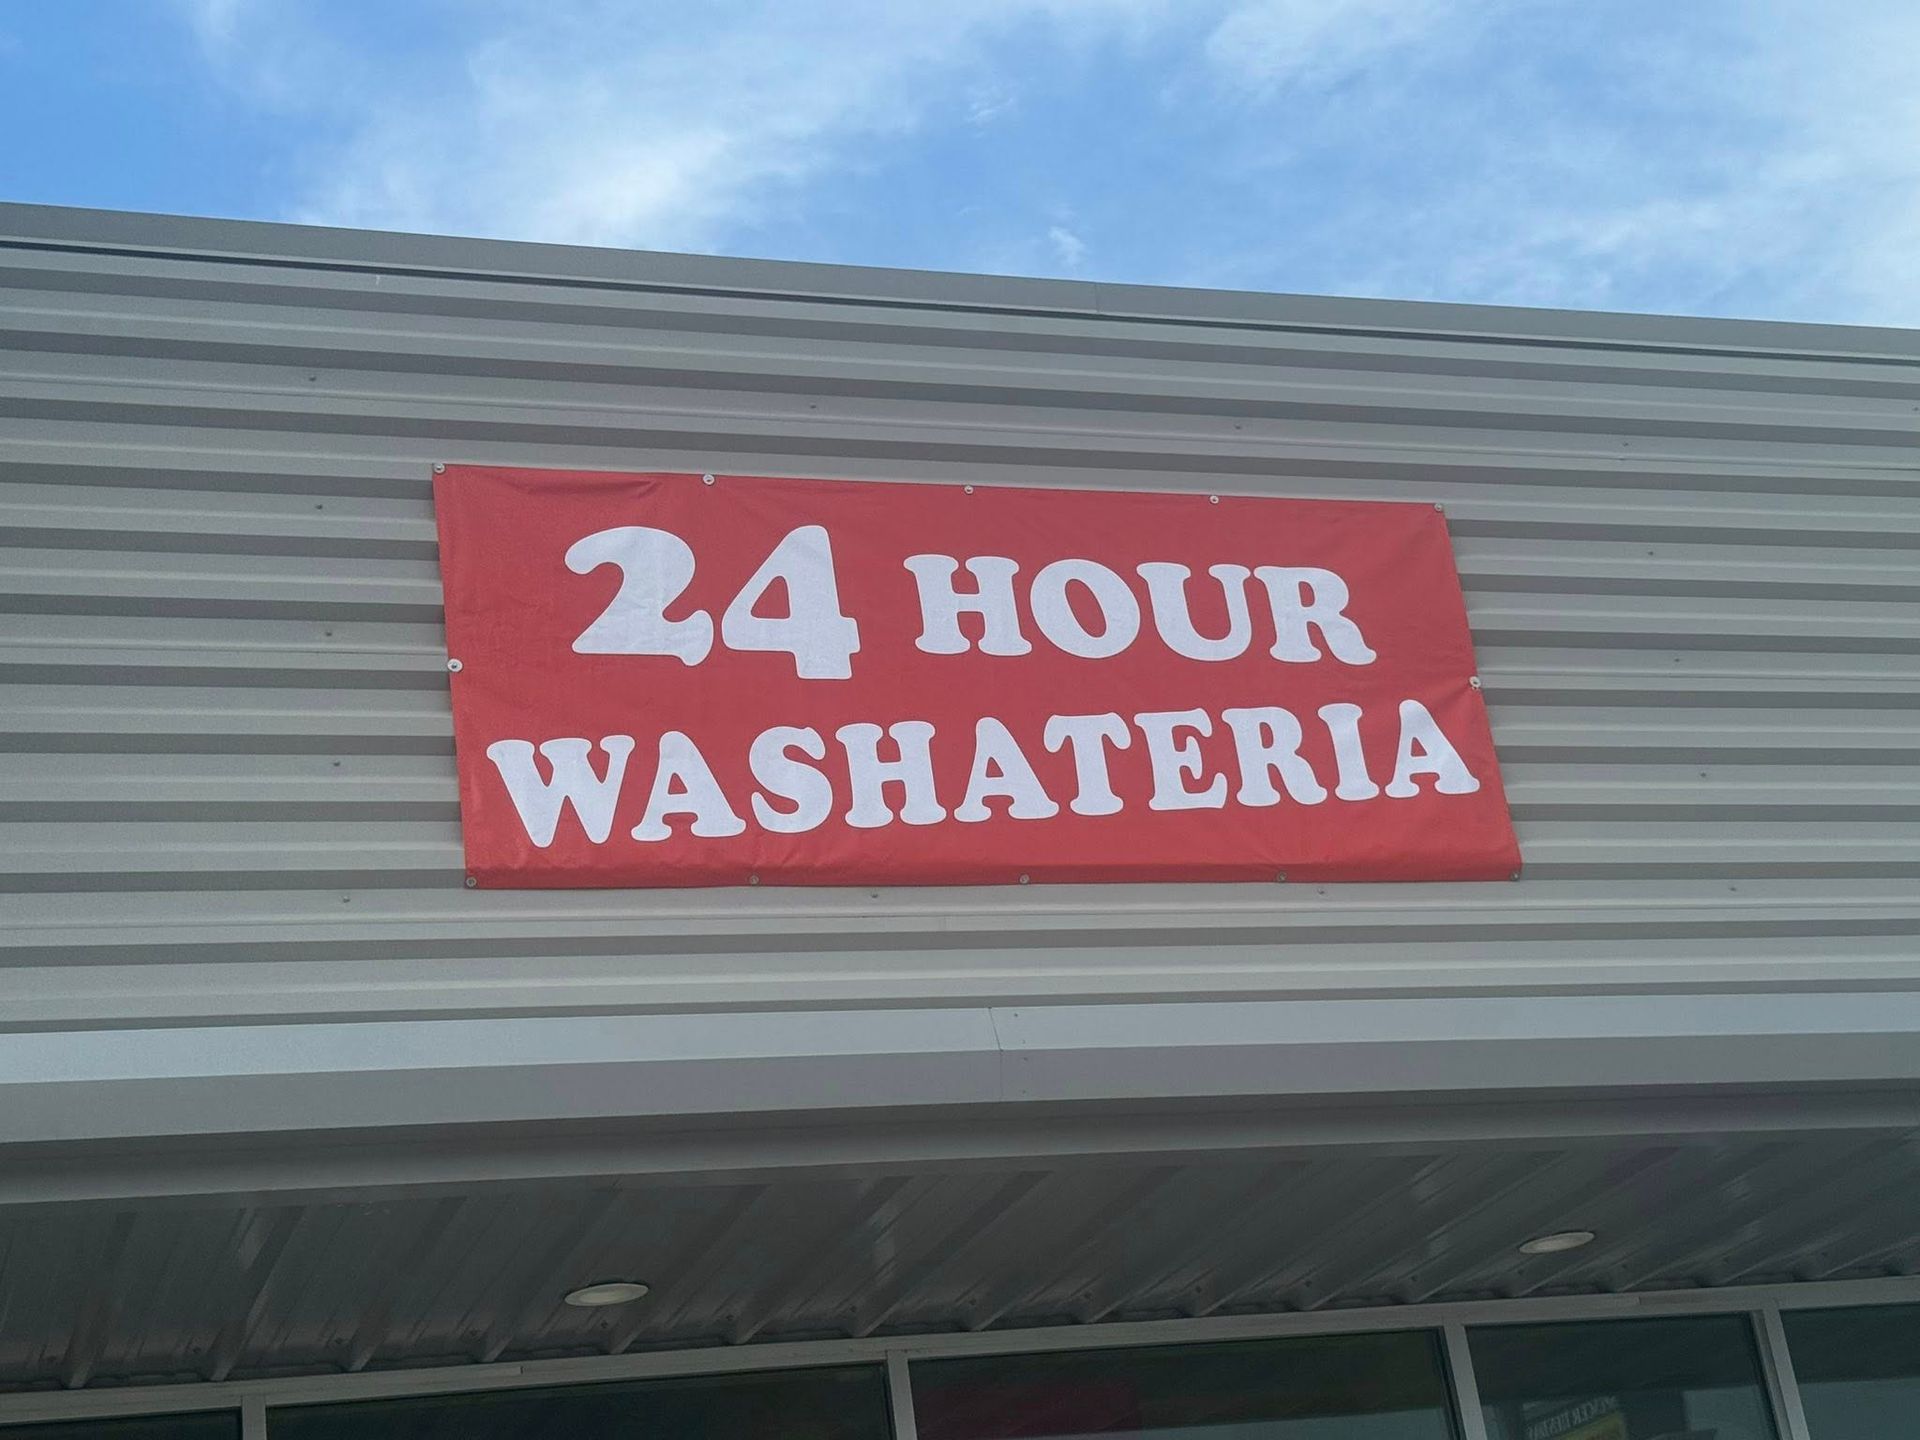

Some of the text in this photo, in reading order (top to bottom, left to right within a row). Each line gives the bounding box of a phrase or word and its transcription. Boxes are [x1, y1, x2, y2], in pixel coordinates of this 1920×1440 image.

[564, 525, 1377, 680] 24 HOUR
[486, 699, 1480, 848] WASHATERIA
